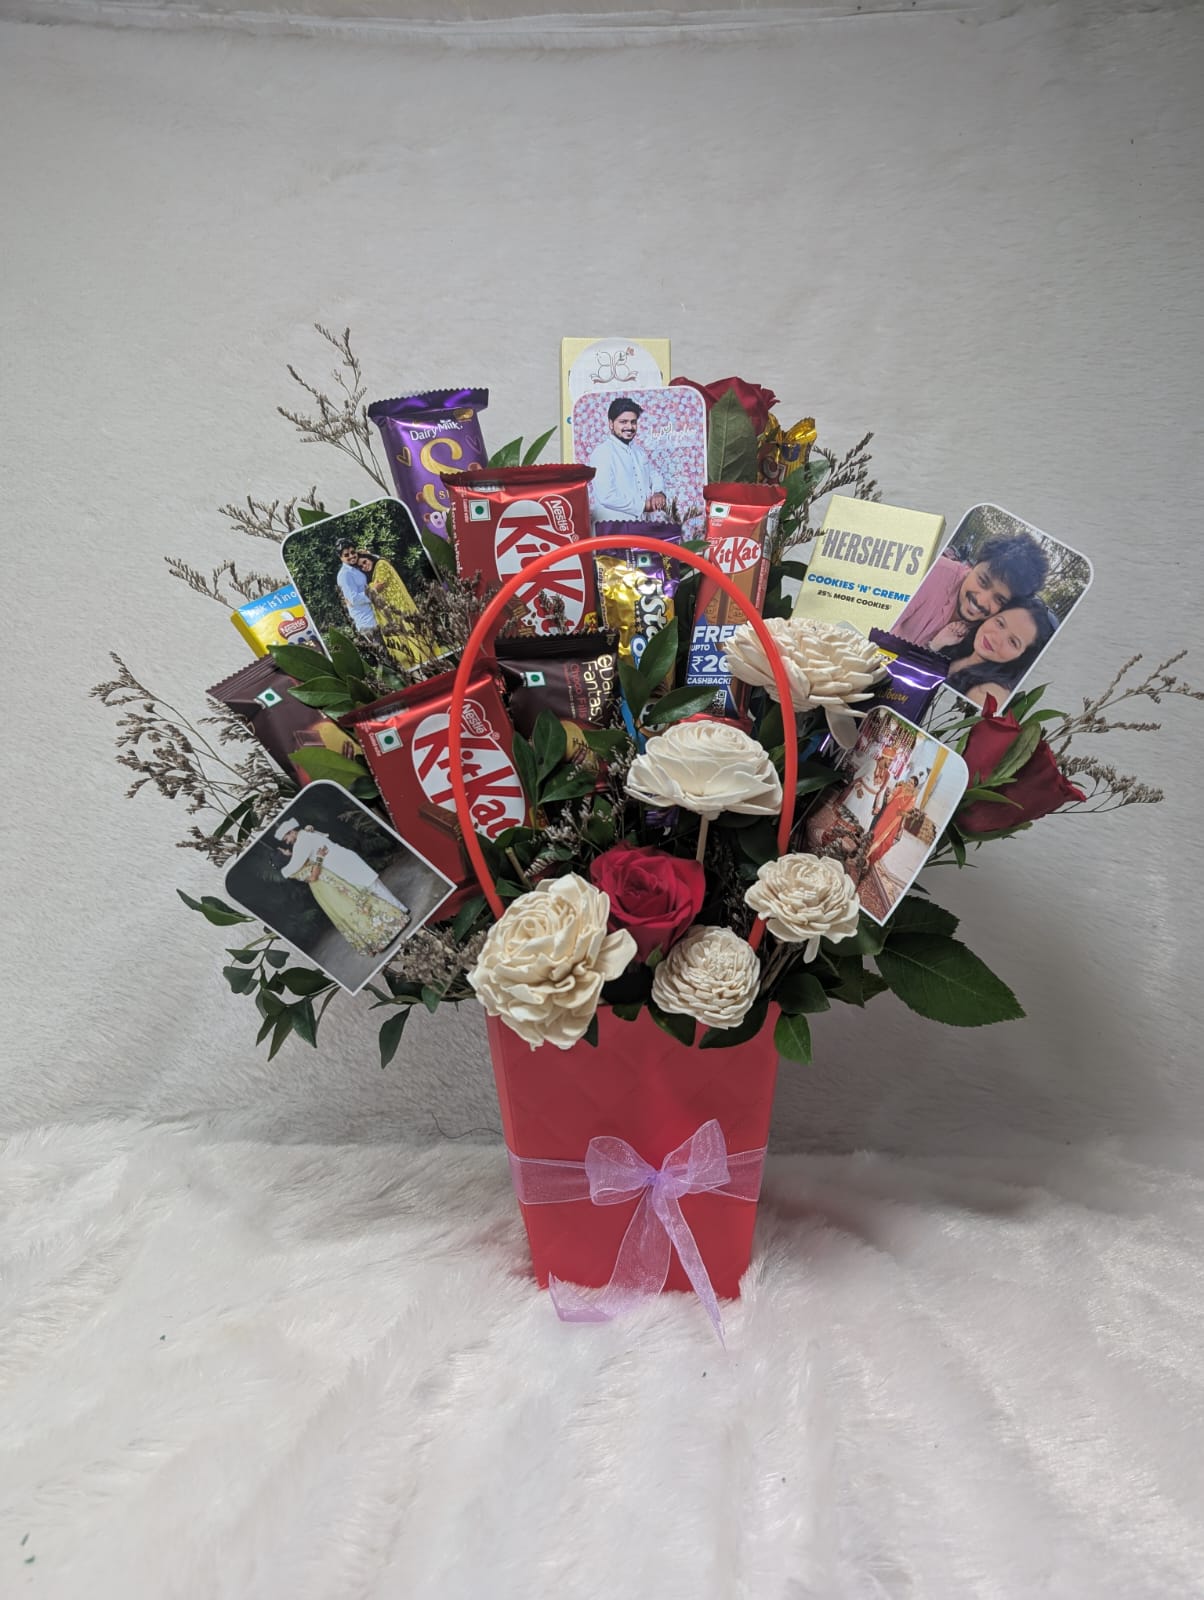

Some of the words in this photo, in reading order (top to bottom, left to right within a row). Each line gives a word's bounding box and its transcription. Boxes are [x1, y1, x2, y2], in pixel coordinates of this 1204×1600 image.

[409, 425, 438, 441] Dairy
[437, 420, 460, 432] Milk
[550, 499, 570, 532] Nestlé
[708, 537, 760, 573] KitKat
[821, 528, 925, 576] HERSHEY'S
[807, 573, 855, 591] COOKIES
[872, 587, 911, 603] CREME
[816, 589, 833, 598] 25%
[833, 593, 856, 603] MORE
[856, 598, 891, 611] COOKIES
[691, 644, 711, 652] UPTO
[692, 625, 737, 643] FRE
[570, 663, 583, 695] Choco
[577, 697, 589, 719] Fills
[687, 677, 732, 685] CASHBACK!
[461, 703, 488, 735] Nestlé
